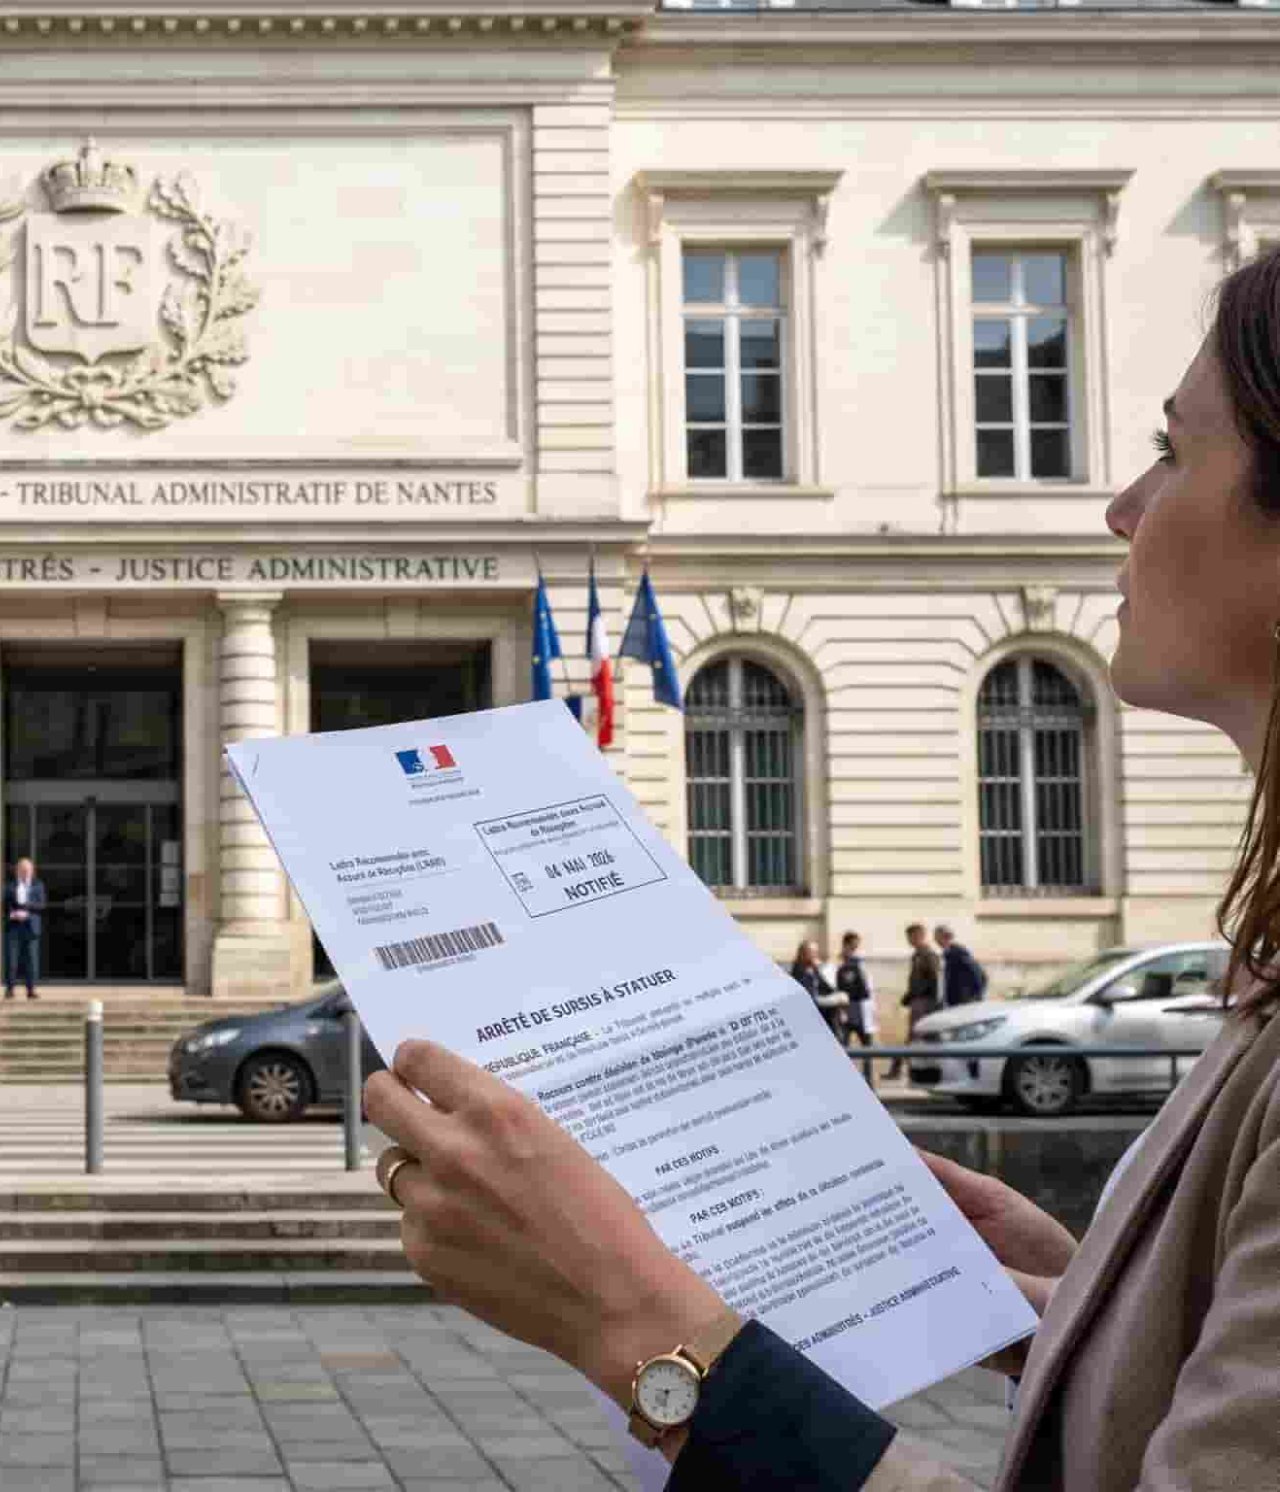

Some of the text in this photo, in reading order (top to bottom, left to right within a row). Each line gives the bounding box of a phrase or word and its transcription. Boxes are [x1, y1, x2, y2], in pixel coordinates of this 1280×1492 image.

[31, 241, 144, 329] RF
[17, 481, 143, 506] TRIBUNAL
[151, 481, 346, 506] ADMINISTRATIF
[354, 481, 388, 506] DE
[396, 481, 498, 506] NANTES
[115, 558, 234, 583] JUSTICE
[247, 556, 499, 582] ADMINISTRATIVE
[563, 870, 625, 900] NOTIFIÉ
[476, 1012, 531, 1043] ARRÊTÉ
[530, 1008, 553, 1026] DE
[552, 993, 602, 1019] SURSIS
[601, 986, 616, 1003] À
[613, 968, 677, 999] STATUER
[689, 1209, 710, 1224] PAR
